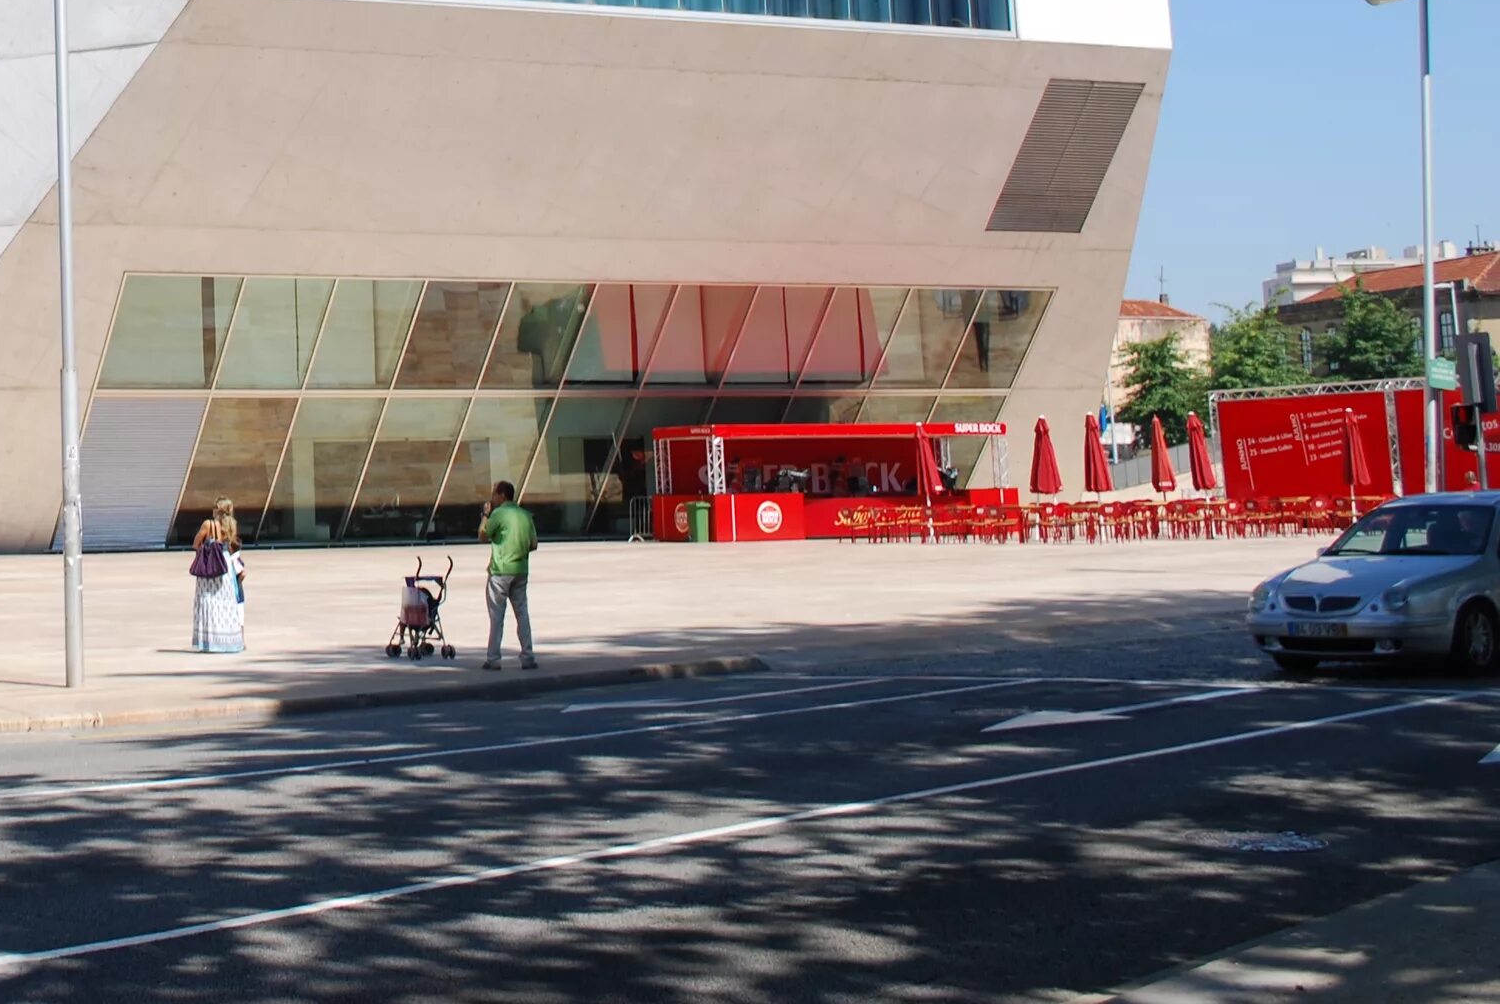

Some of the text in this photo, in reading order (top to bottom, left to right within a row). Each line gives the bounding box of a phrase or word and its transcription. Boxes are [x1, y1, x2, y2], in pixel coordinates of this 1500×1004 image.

[954, 422, 1002, 433] SUPER BOCK
[811, 462, 903, 493] BCK
